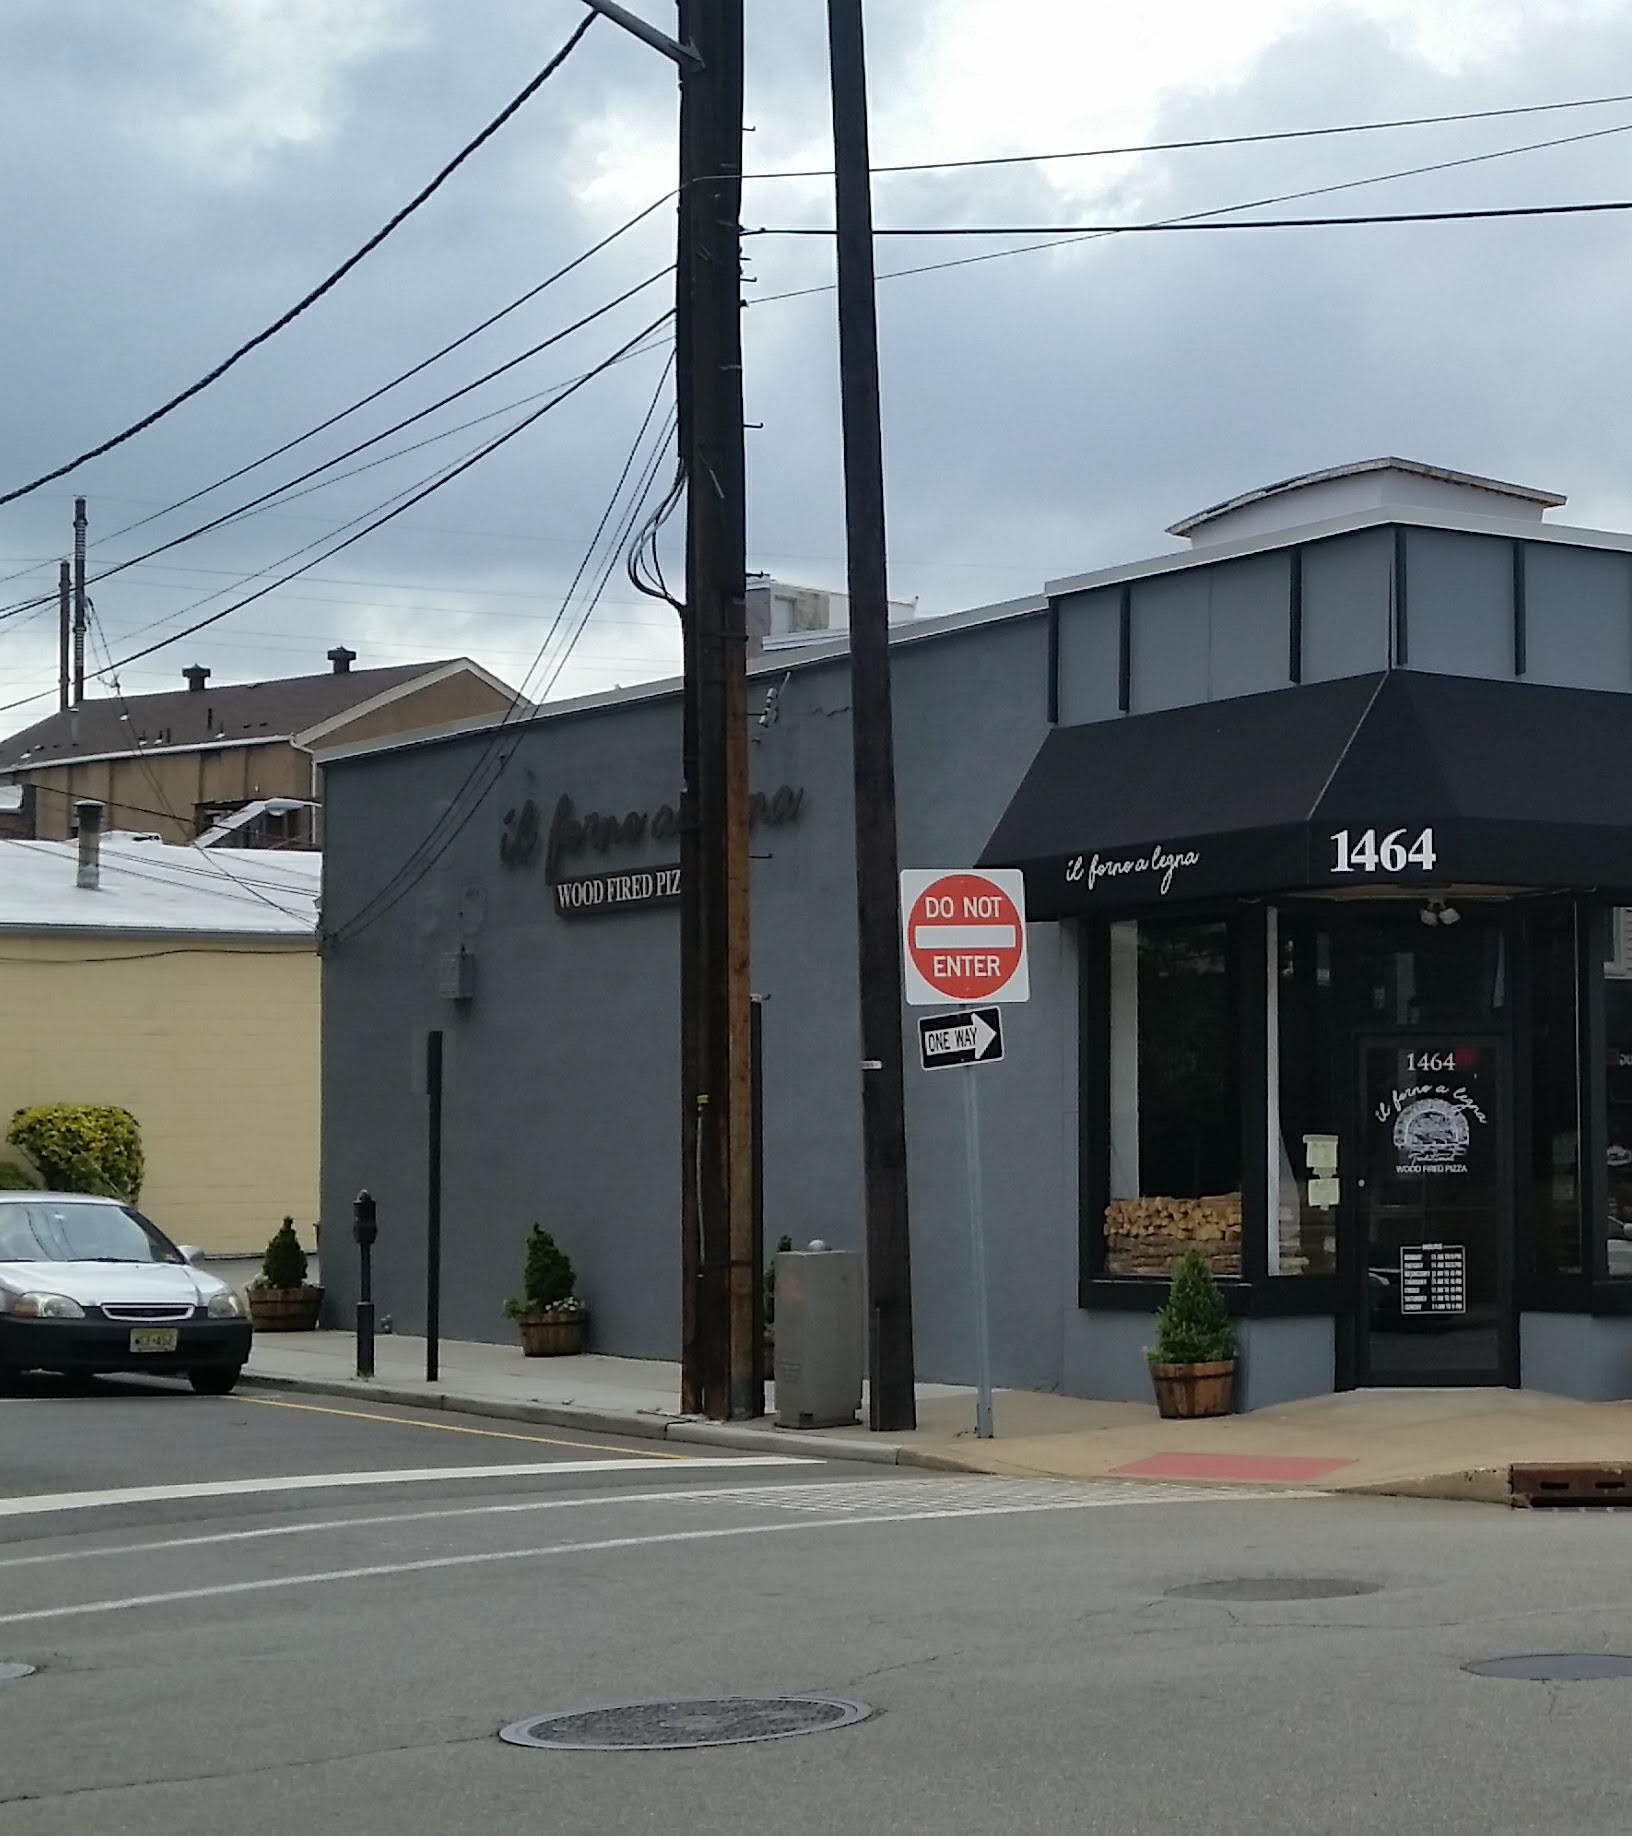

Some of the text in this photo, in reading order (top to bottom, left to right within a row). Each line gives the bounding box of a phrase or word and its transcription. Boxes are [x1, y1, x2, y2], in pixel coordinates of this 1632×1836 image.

[1330, 828, 1436, 872] 1464
[1066, 845, 1199, 895] il forno a legna
[557, 868, 681, 908] WOOD FIRED PIZ
[925, 896, 1003, 919] DO NOT
[933, 955, 1001, 978] ENTER
[928, 1027, 978, 1053] ONE WAY
[1407, 1051, 1456, 1072] 1464
[1396, 1164, 1421, 1174] WOOD
[1445, 1163, 1468, 1174] PIZZA
